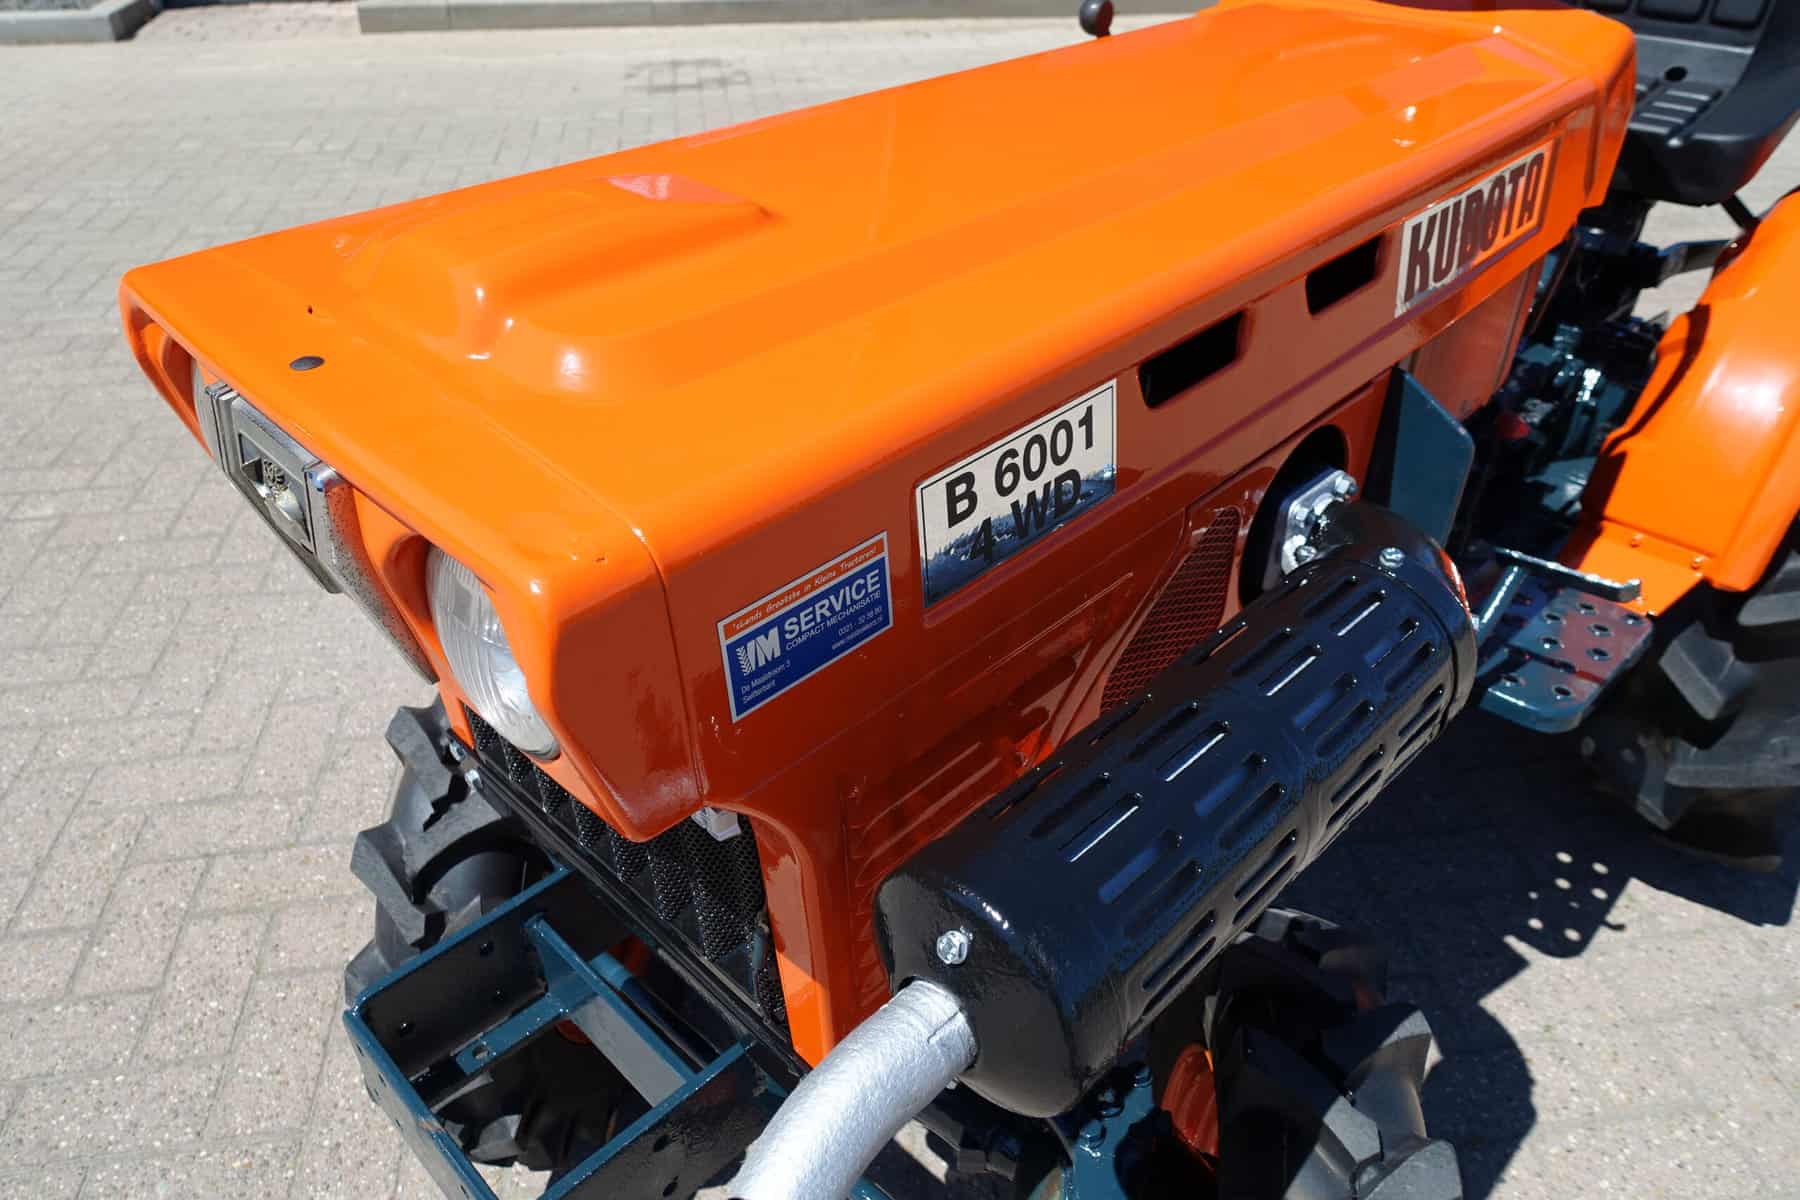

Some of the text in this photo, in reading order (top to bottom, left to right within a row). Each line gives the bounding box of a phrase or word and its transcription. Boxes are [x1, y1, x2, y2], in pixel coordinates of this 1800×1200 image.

[1403, 152, 1545, 304] KUBOTA
[945, 404, 1094, 529] B 6001
[970, 468, 1082, 562] 4 WD
[783, 568, 881, 640] SERVICE
[785, 622, 825, 651] COMPACT
[826, 591, 881, 628] MECHANISATIE
